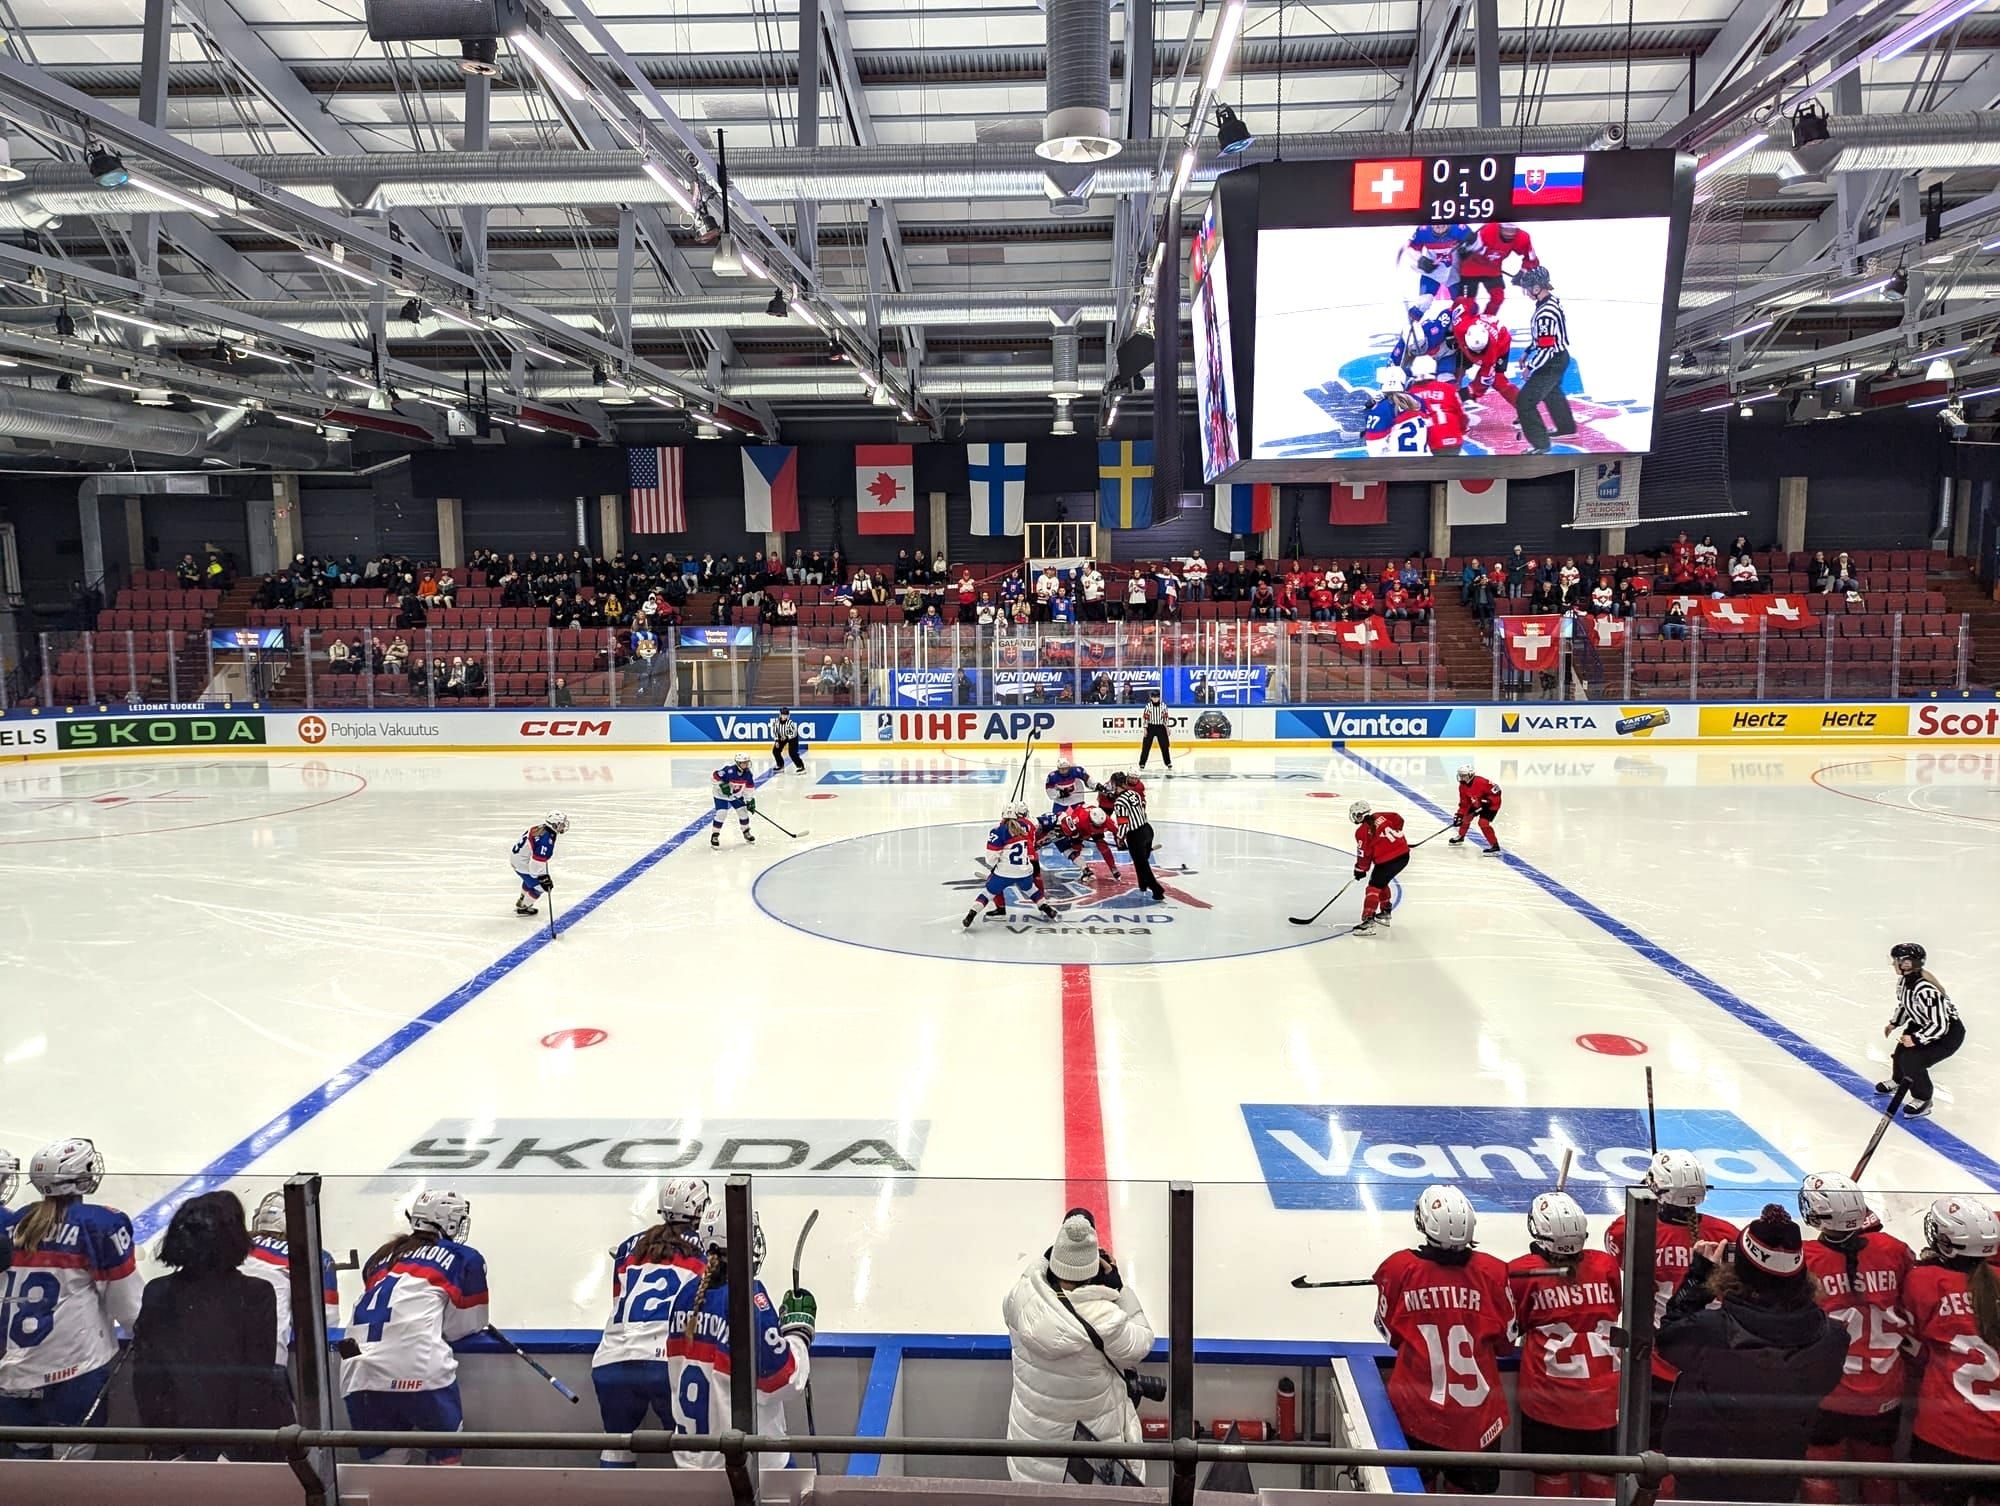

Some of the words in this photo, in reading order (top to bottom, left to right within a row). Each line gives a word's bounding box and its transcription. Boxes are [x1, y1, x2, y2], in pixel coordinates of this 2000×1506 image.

[1433, 159, 1450, 183] 0
[1480, 157, 1497, 182] 0
[1459, 182, 1469, 197] 1
[1431, 198, 1494, 220] 19:59
[994, 672, 1062, 682] VENTONIEMI
[1090, 670, 1160, 682] VNTONIEMI
[520, 720, 612, 736] CCM
[715, 715, 817, 742] Vanta
[900, 713, 978, 740] IIHF
[983, 712, 1055, 740] APP
[1127, 717, 1189, 728] TIOT
[1323, 711, 1428, 737] Vantaa
[1525, 716, 1598, 730] VARTA
[1622, 714, 1652, 725] VARTA
[1732, 711, 1788, 728] Hertz
[1821, 711, 1877, 727] Hertz
[331, 722, 377, 740] Pohjola
[380, 722, 440, 737] Vakuutus
[1006, 925, 1152, 935] Vantaa
[707, 1225, 714, 1237] 9
[1817, 1270, 1897, 1296] CHSNER
[614, 1267, 682, 1324] 12
[1403, 1286, 1481, 1313] METTLER
[353, 1275, 402, 1343] 4
[764, 1326, 787, 1354] 9
[1536, 1319, 1622, 1379] 24
[1417, 1324, 1490, 1408] 19
[397, 1380, 423, 1390] IIHF
[677, 1364, 710, 1435] 9
